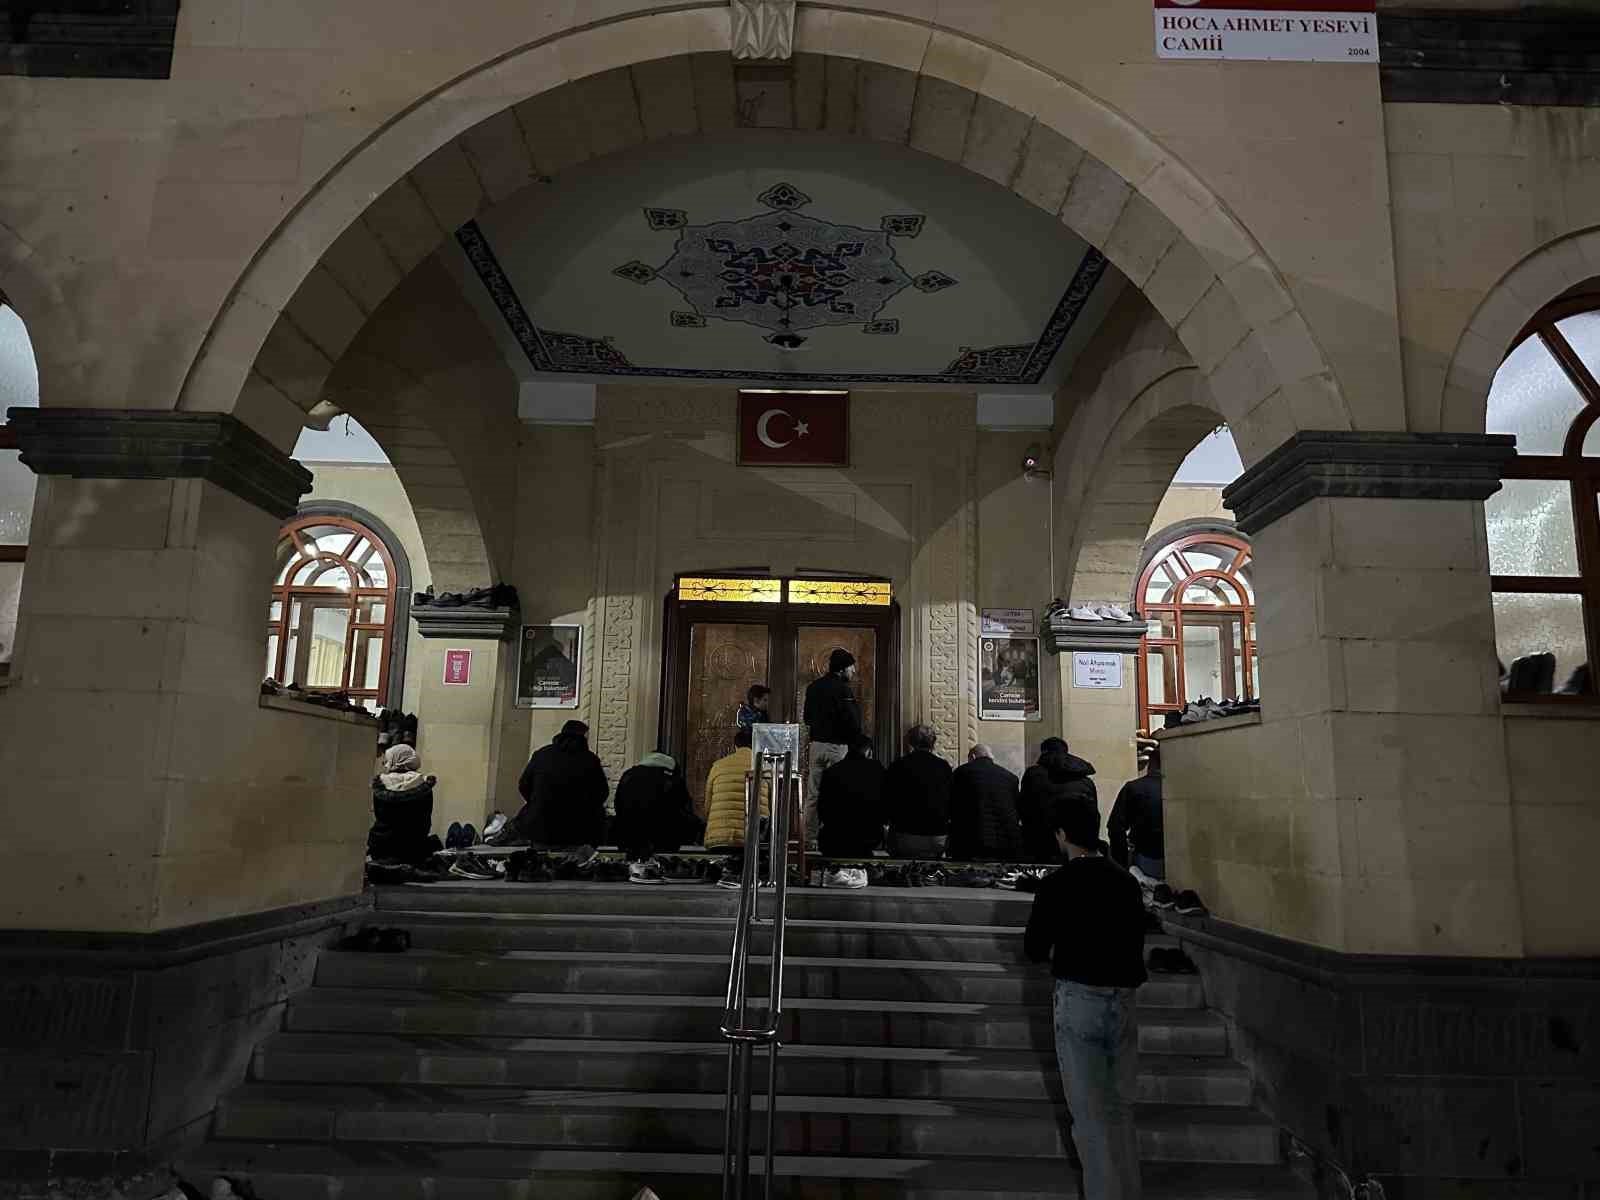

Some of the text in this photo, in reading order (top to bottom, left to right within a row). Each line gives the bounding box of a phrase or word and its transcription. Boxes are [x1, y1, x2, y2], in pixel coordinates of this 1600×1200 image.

[1163, 16, 1370, 34] HOCA AHMET YESEVİ
[1163, 34, 1223, 51] CAMİİ
[1347, 47, 1370, 56] 2004
